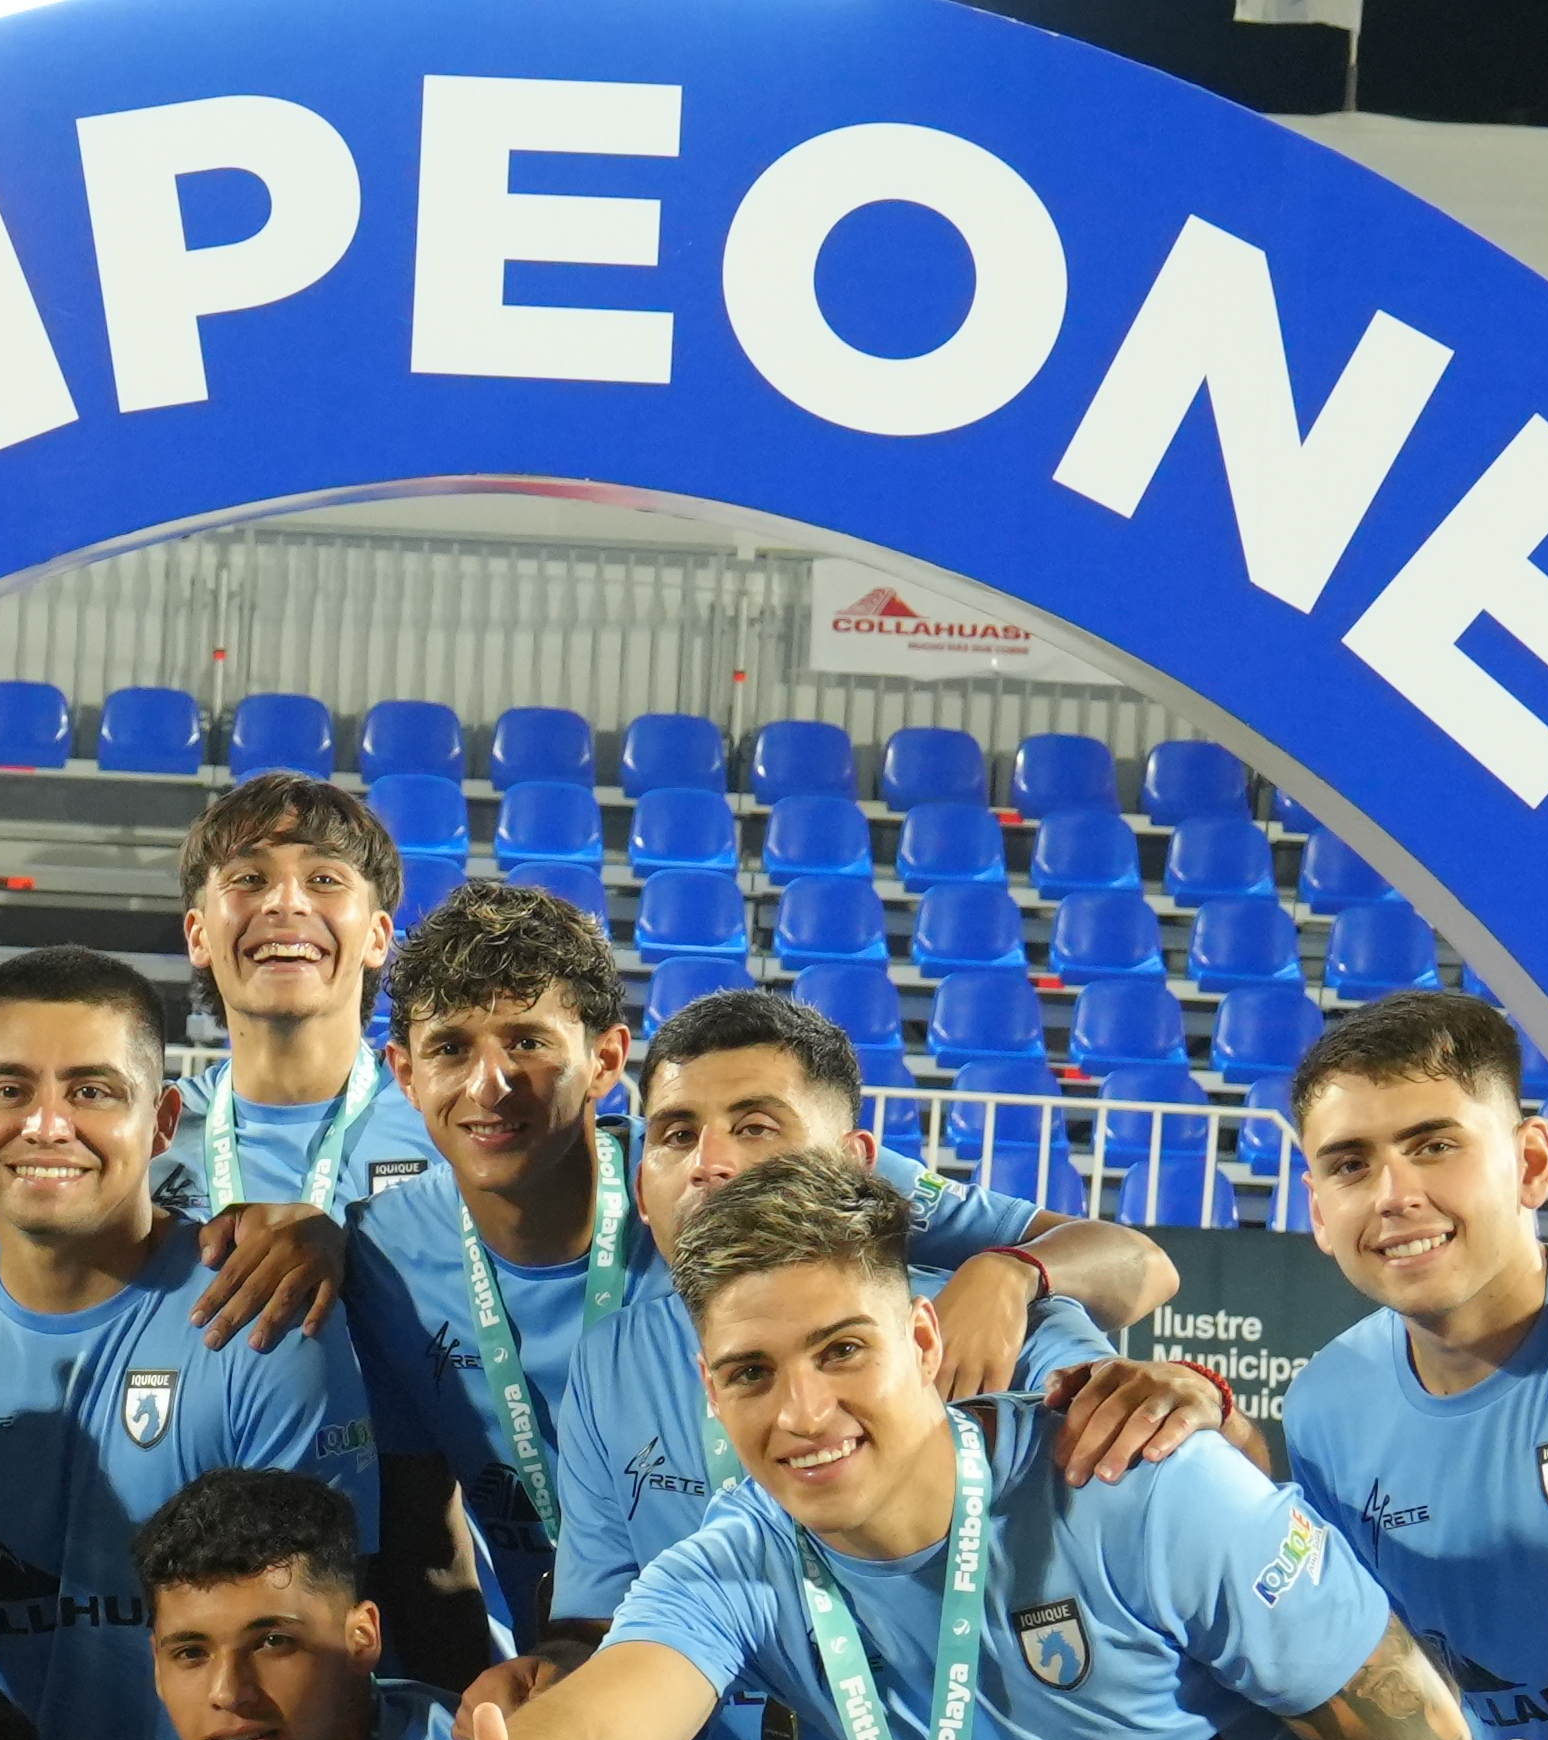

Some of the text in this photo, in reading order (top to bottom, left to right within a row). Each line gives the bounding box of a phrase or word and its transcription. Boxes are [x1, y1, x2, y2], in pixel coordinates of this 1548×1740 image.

[212, 1136, 235, 1206] Playa
[374, 1161, 420, 1176] IQUIQUE
[596, 1191, 628, 1267] Playa
[462, 1237, 500, 1328] Fútbol
[1153, 1305, 1263, 1341] Ilustre
[130, 1373, 170, 1387] IQUIQUE
[504, 1383, 539, 1459] Playa
[953, 1486, 983, 1593] Fútbol
[1019, 1602, 1072, 1627] IQUIQUE
